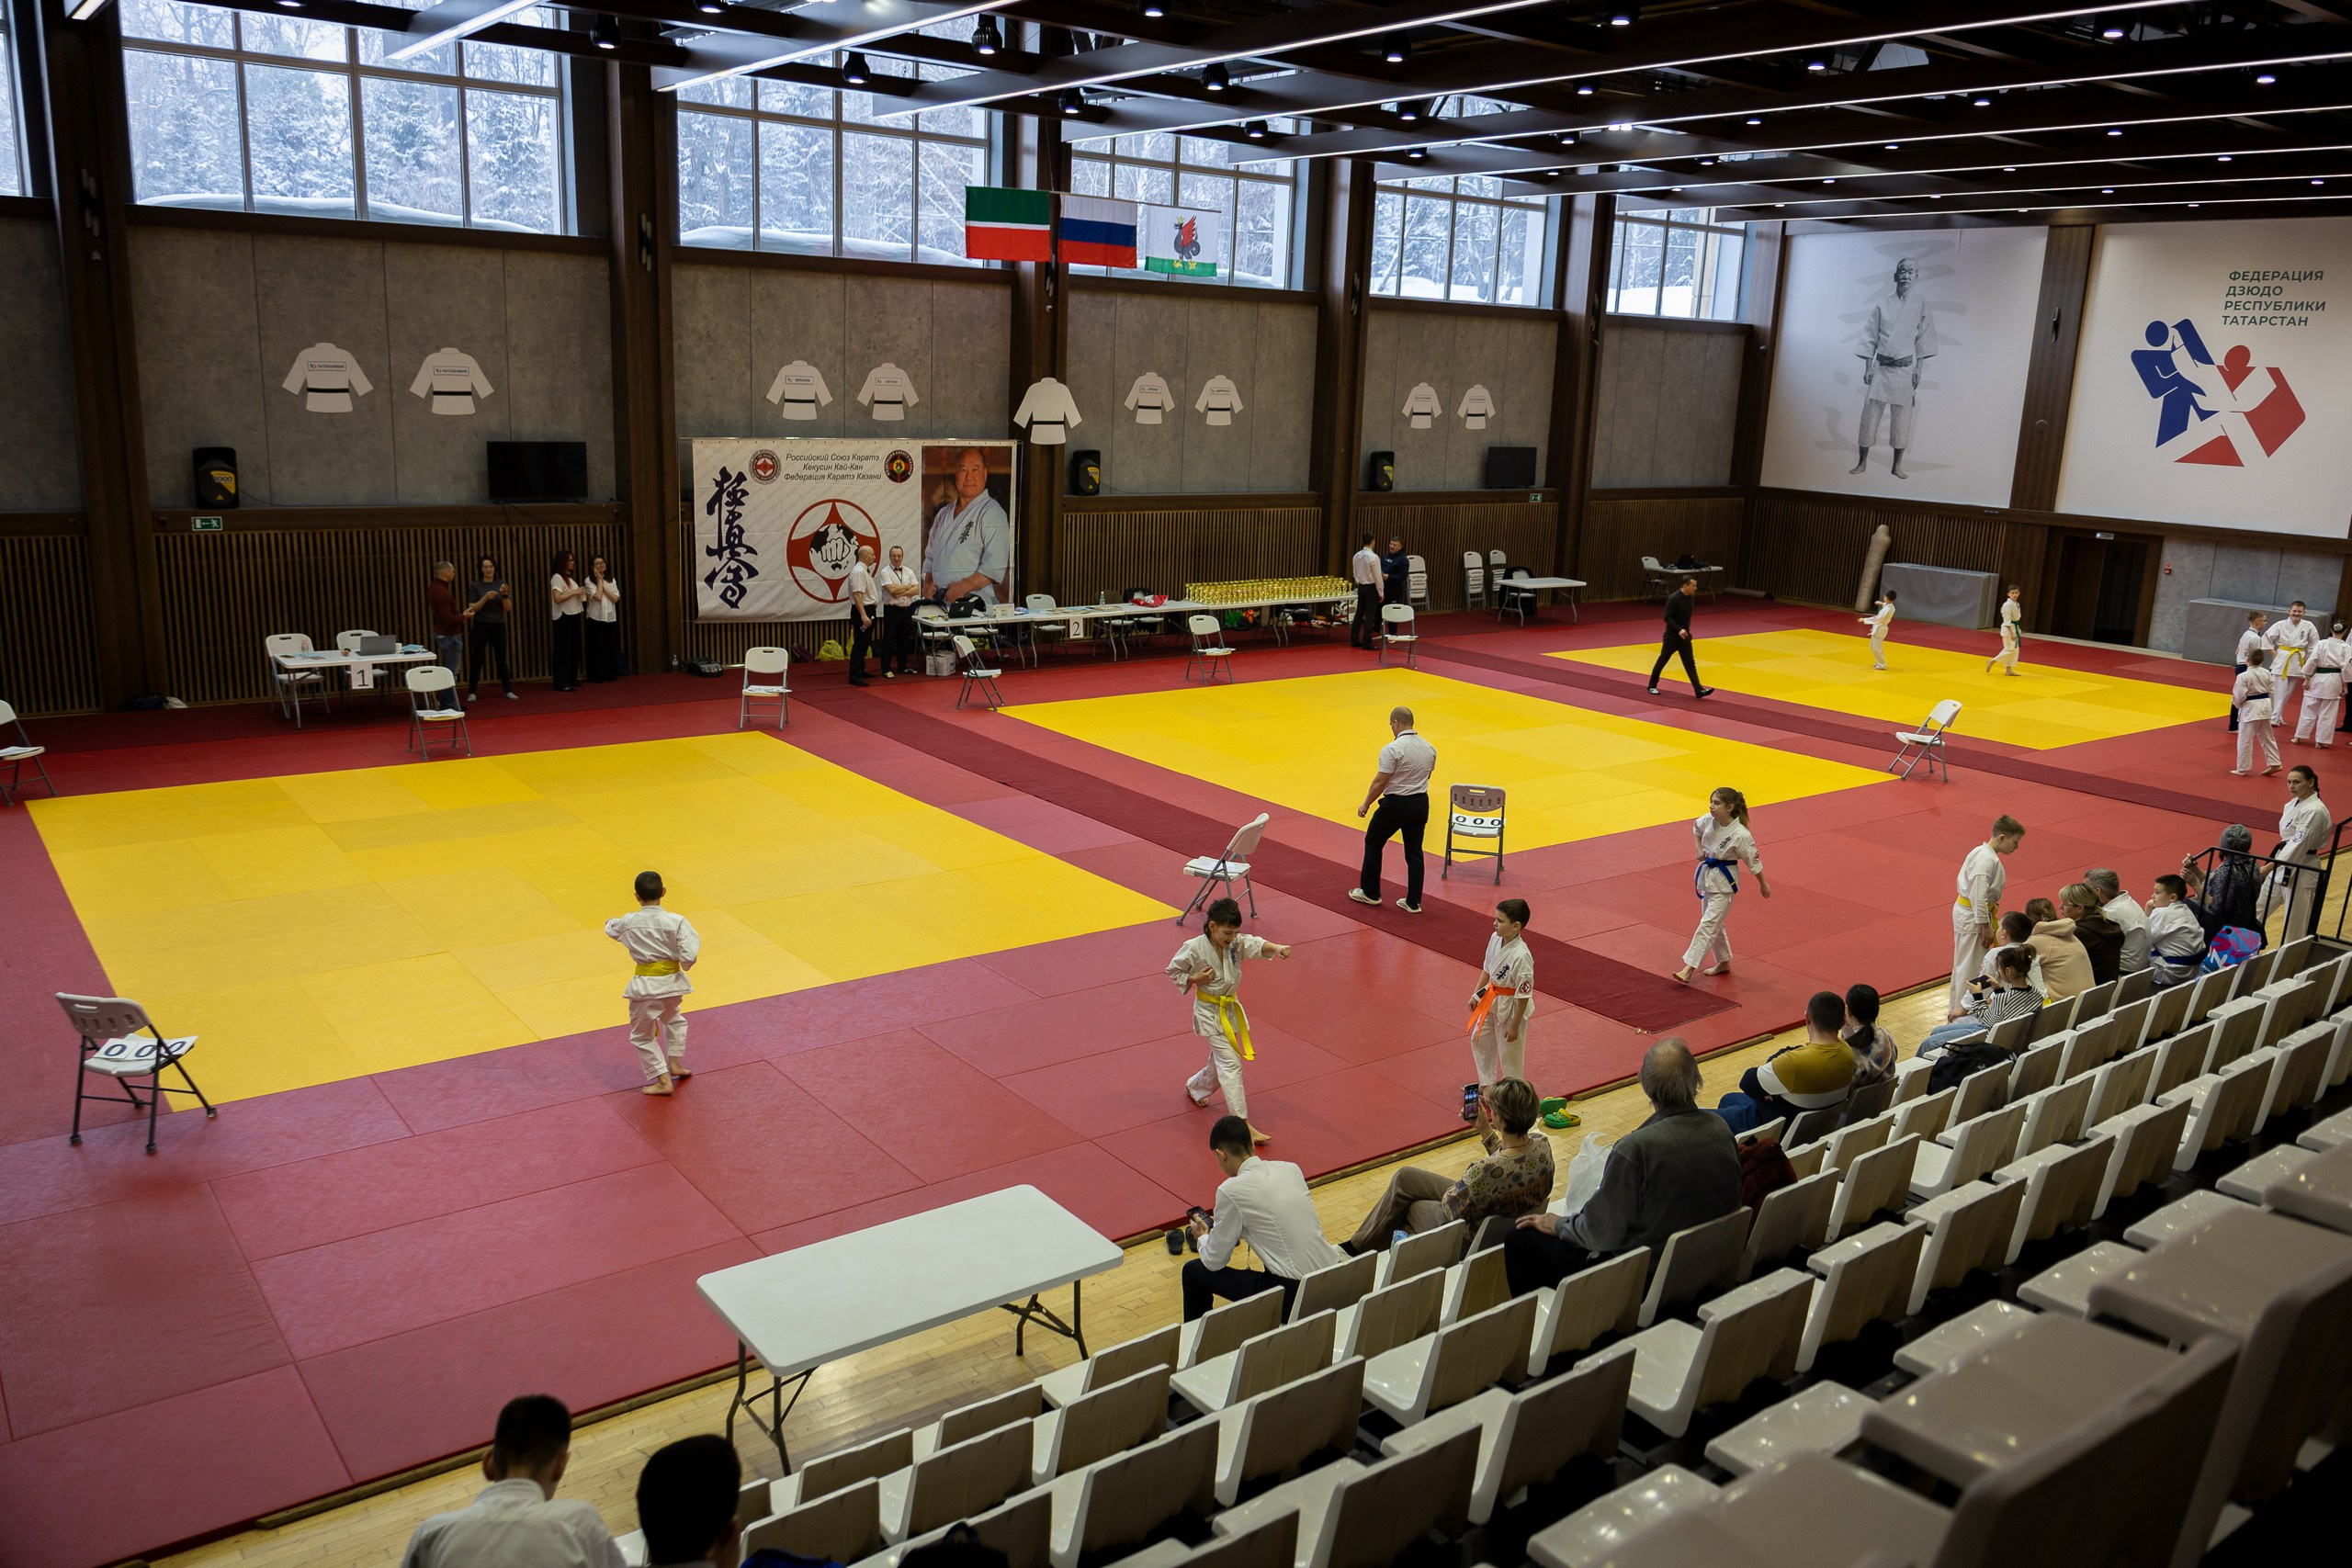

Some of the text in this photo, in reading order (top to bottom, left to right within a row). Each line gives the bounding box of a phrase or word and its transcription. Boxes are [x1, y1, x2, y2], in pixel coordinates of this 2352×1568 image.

[2229, 270, 2324, 283] ФЕДЕРАЦИЯ
[2225, 286, 2283, 298] ДЗЮДО
[2223, 300, 2325, 311] РЕСПУБЛИКИ
[2222, 315, 2308, 326] ТАТАРСТАН
[786, 453, 879, 462] Российский Союз Каратэ
[802, 463, 864, 472] Кекусин Кай-Кан
[213, 475, 233, 483] 1000
[784, 472, 882, 481] Федерация Каратэ Казани
[1072, 621, 1080, 637] 2
[356, 669, 369, 687] 1
[104, 1043, 127, 1057] 0
[135, 1044, 158, 1058] 0
